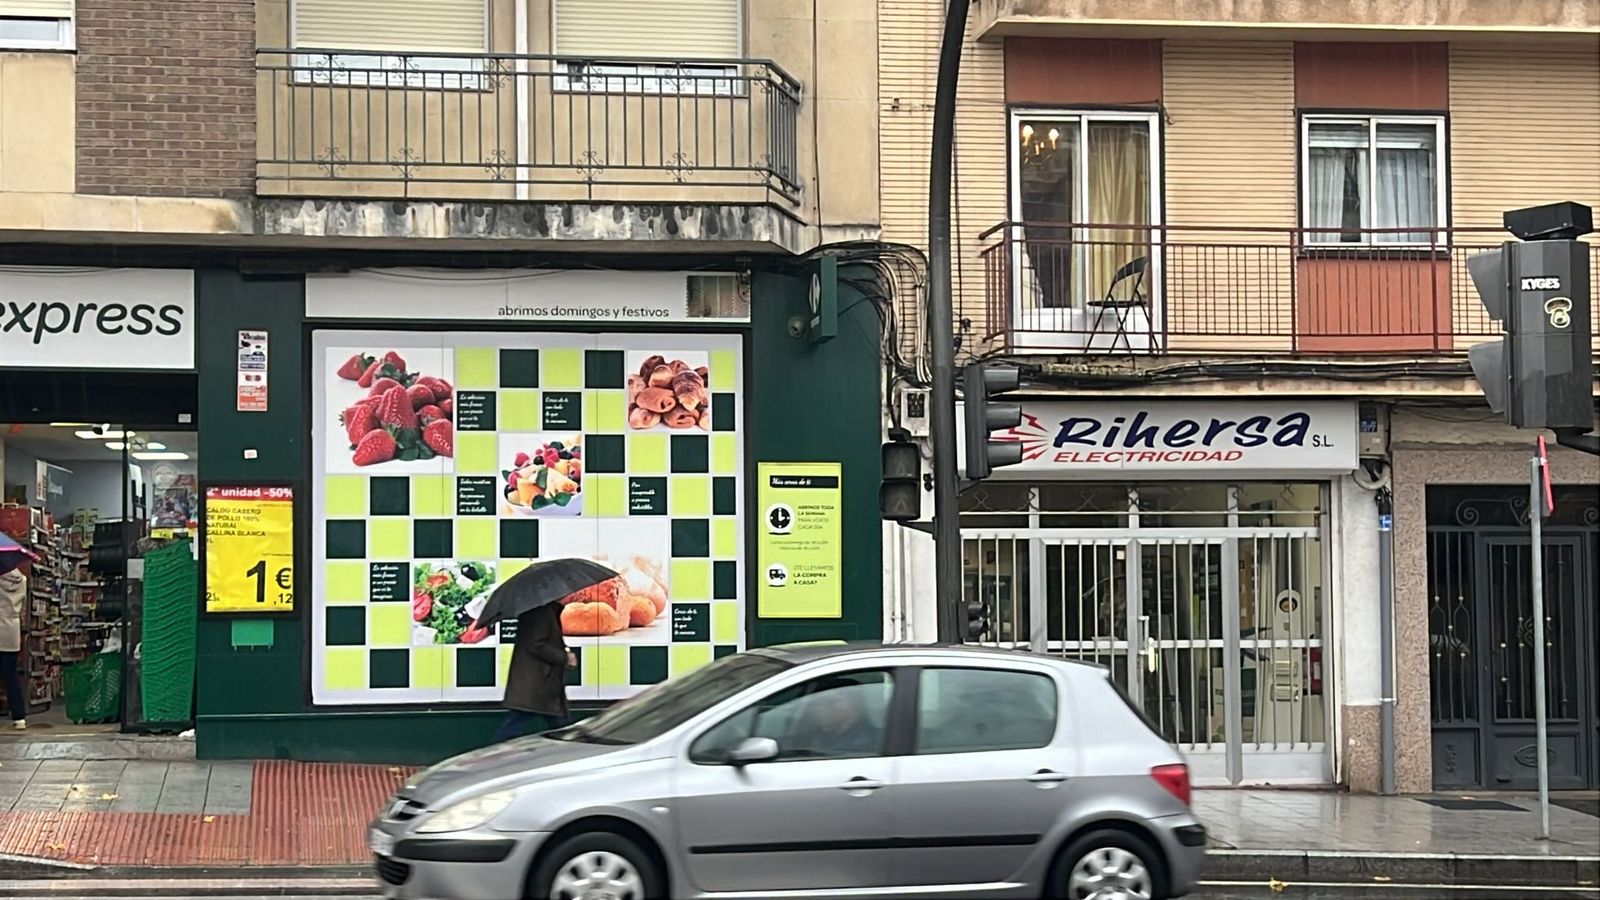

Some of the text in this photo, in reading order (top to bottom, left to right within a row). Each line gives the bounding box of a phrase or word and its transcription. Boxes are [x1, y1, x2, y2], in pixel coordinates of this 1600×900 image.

[0, 302, 184, 344] xpress
[498, 305, 669, 320] abrimos domingos y festivos
[1052, 411, 1334, 448] Rihersa S.L.
[1053, 450, 1243, 463] ELECTRICIDAD
[221, 487, 261, 497] unidad
[264, 488, 293, 498] -50%
[246, 560, 266, 603] 1
[276, 567, 292, 590] €
